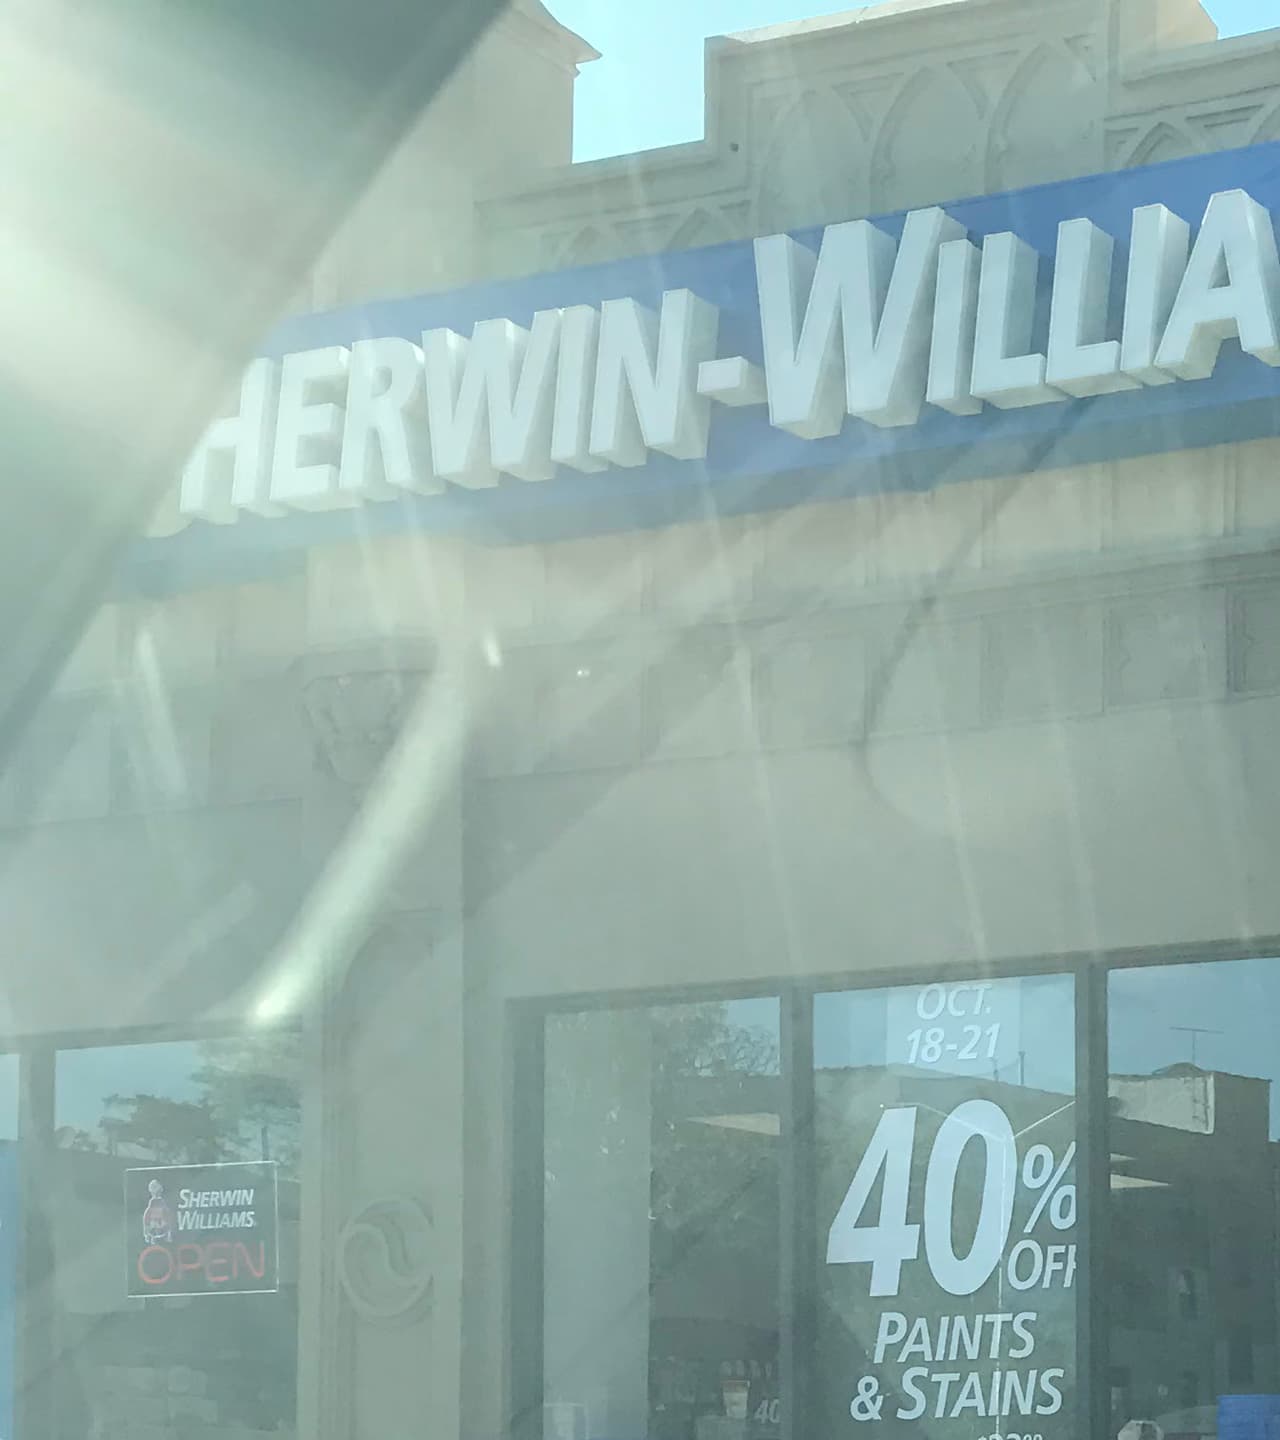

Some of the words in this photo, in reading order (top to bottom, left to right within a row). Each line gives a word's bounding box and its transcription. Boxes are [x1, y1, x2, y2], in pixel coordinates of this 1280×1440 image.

[916, 982, 993, 1020] OCT.
[907, 1022, 1001, 1064] 18-21
[177, 1188, 254, 1209] SHERWIN
[176, 1211, 255, 1231] WILLIAMS
[137, 1241, 265, 1284] OPEN
[873, 1311, 1037, 1364] PAINTS
[850, 1376, 883, 1421] &
[896, 1366, 1065, 1421] STAINS
